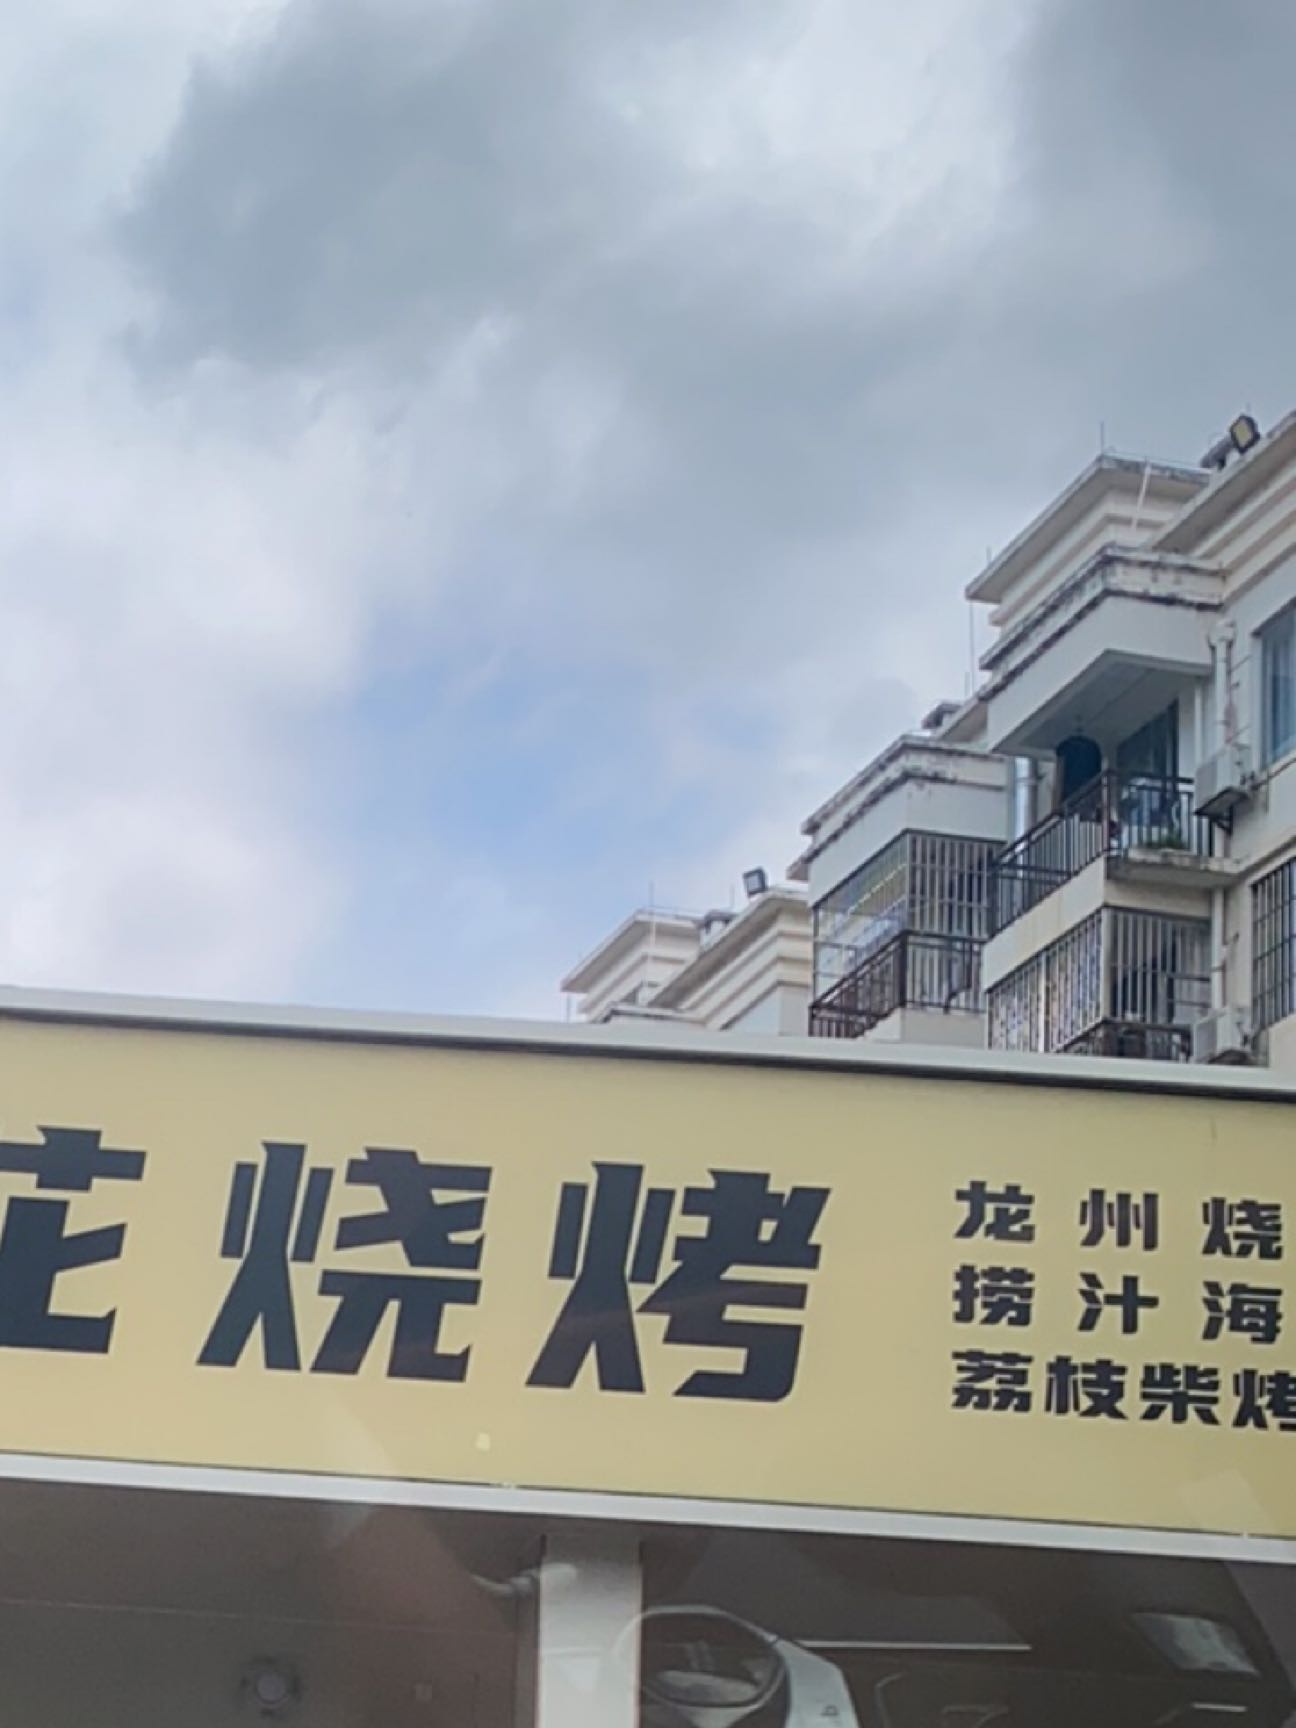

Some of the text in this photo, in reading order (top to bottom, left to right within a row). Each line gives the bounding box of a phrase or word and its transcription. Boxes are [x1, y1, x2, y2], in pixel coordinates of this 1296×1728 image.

[953, 1180, 1283, 1260] 龙州烧
[952, 1264, 1284, 1345] 捞汁海
[951, 1349, 1296, 1432] 荔枝柴烤
